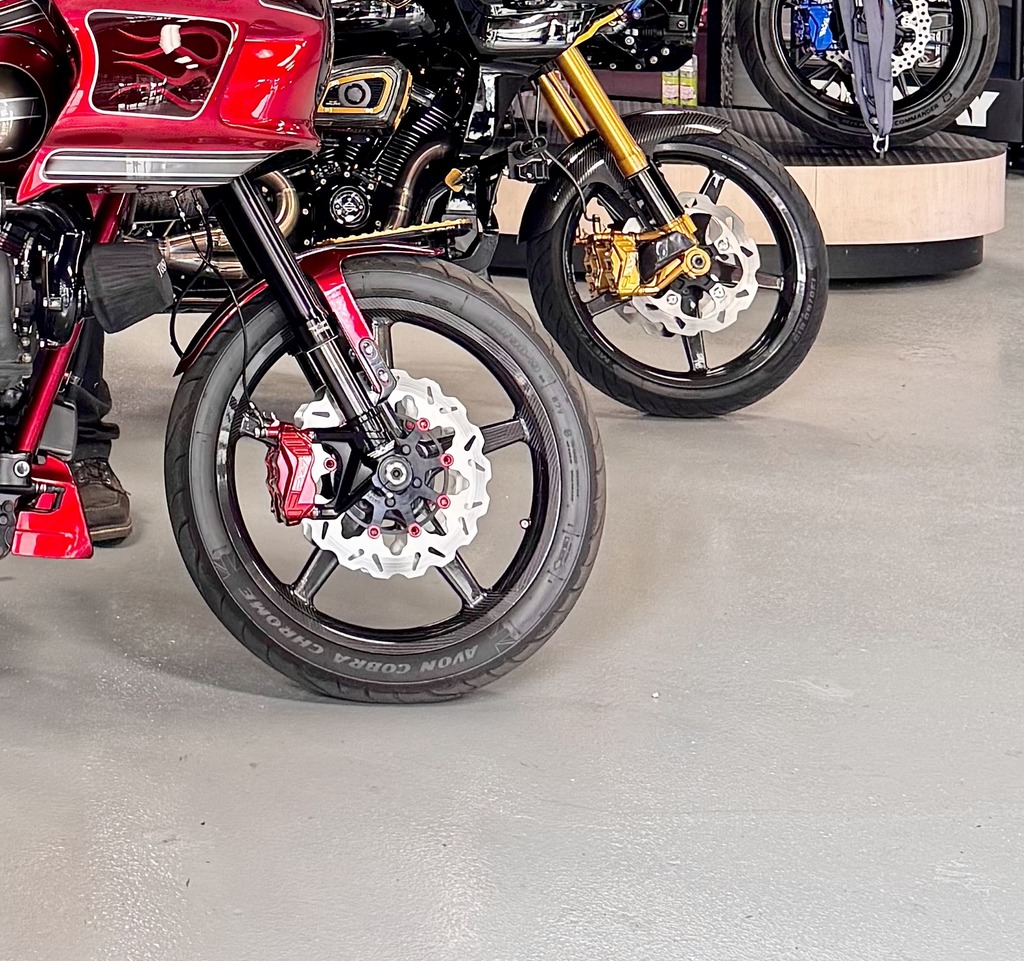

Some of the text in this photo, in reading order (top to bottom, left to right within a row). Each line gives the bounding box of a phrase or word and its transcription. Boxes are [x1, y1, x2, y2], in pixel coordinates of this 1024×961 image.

[894, 104, 939, 126] COMMANDER
[238, 587, 479, 675] AVON COBRA CHROME
